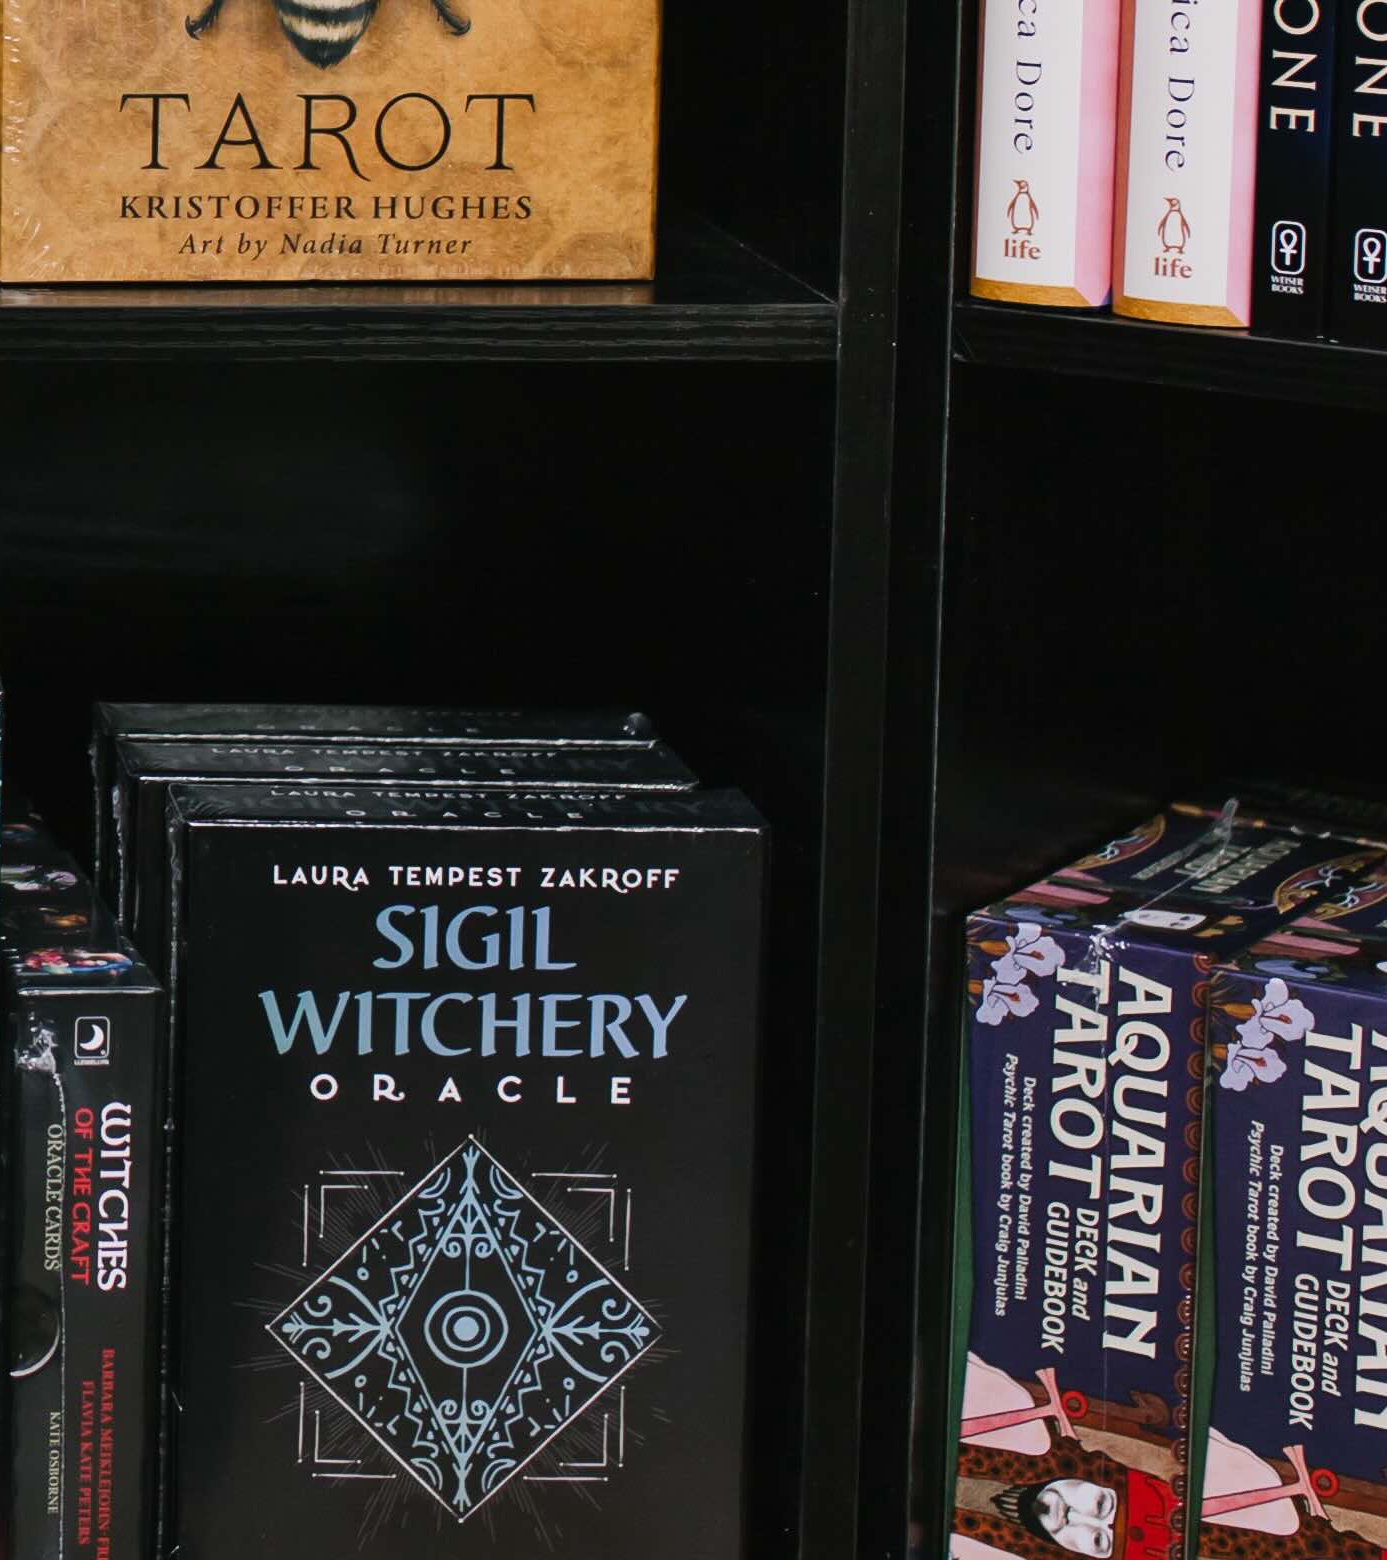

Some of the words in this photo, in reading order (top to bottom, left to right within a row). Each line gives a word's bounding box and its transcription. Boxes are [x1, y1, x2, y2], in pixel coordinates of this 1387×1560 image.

[119, 93, 536, 181] TAROT
[120, 195, 354, 219] KRISTOFFER
[373, 195, 533, 219] HUGHES
[178, 233, 224, 255] Art
[237, 233, 267, 259] by
[280, 233, 363, 255] Nadia
[377, 233, 473, 255] Turner
[274, 866, 369, 890] LAURA
[389, 866, 522, 887] TEMPEST
[541, 868, 679, 894] ZAKROFF
[372, 905, 577, 971] SIGIL
[259, 989, 688, 1058] WITCHERY
[310, 1075, 632, 1105] ORACLE
[1049, 964, 1112, 1199] TAROT
[1101, 964, 1174, 1360] AQUARIAN
[97, 1102, 133, 1292] WITCHES
[1040, 1202, 1071, 1355] GUIDEBOOK
